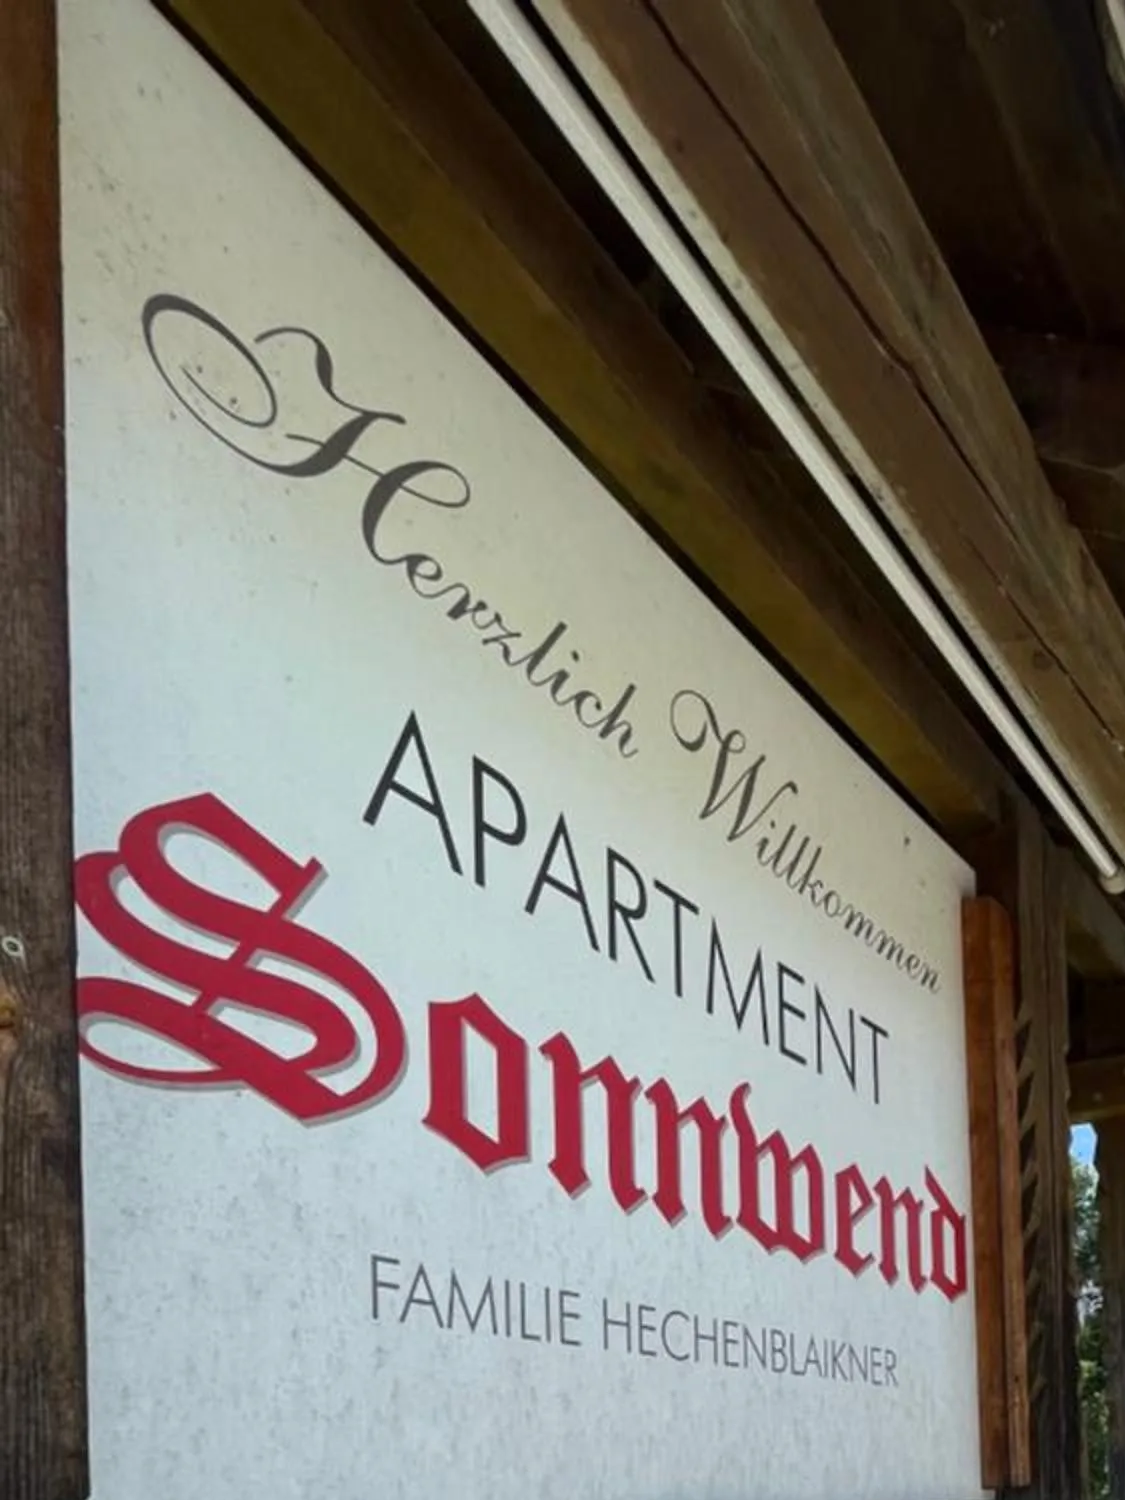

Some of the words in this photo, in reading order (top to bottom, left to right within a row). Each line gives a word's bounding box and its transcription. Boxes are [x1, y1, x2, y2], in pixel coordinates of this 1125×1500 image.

[141, 293, 639, 759] Herzlich
[668, 689, 942, 994] Willkommen
[73, 791, 970, 1303] Sonnwend
[362, 710, 889, 1105] APARTMENT
[370, 1255, 584, 1347] FAMILIE
[600, 1298, 899, 1387] HECHENBLAIKNER
